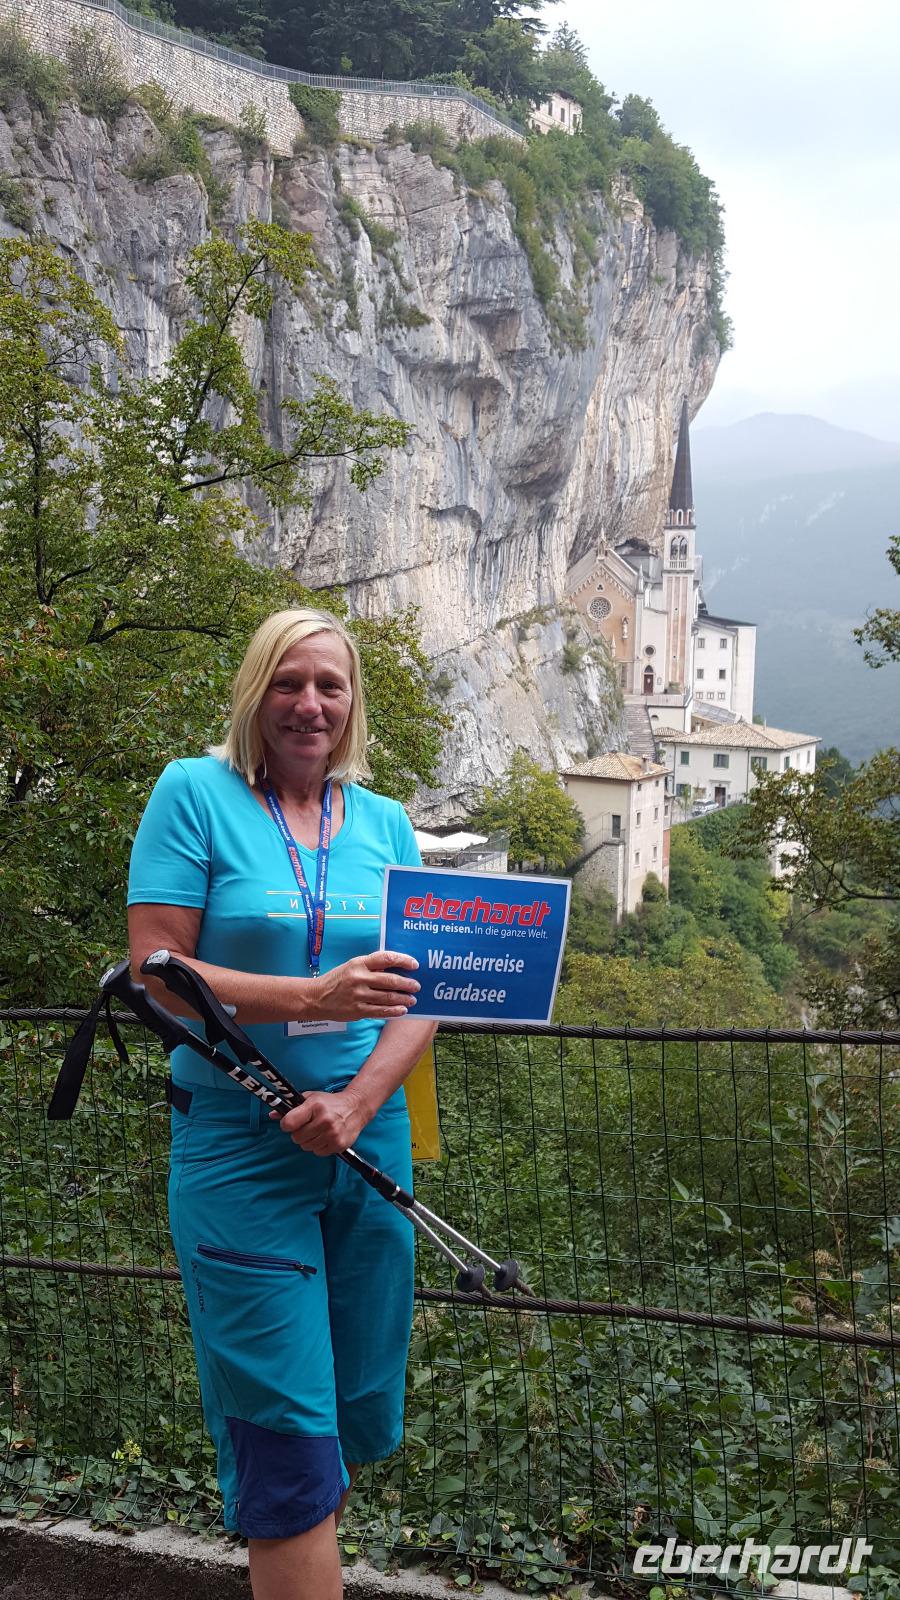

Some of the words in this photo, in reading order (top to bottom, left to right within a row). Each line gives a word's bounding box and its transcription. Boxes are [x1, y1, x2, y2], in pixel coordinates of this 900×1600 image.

[403, 892, 551, 927] eberhardt
[403, 920, 439, 934] Richtig
[441, 924, 474, 934] reisen.
[475, 925, 483, 935] In
[485, 926, 499, 936] die
[501, 930, 527, 939] ganze
[528, 928, 548, 939] Welt.
[427, 949, 525, 973] Wanderreise
[433, 981, 507, 1003] Gardasee
[227, 1066, 282, 1107] LEKI
